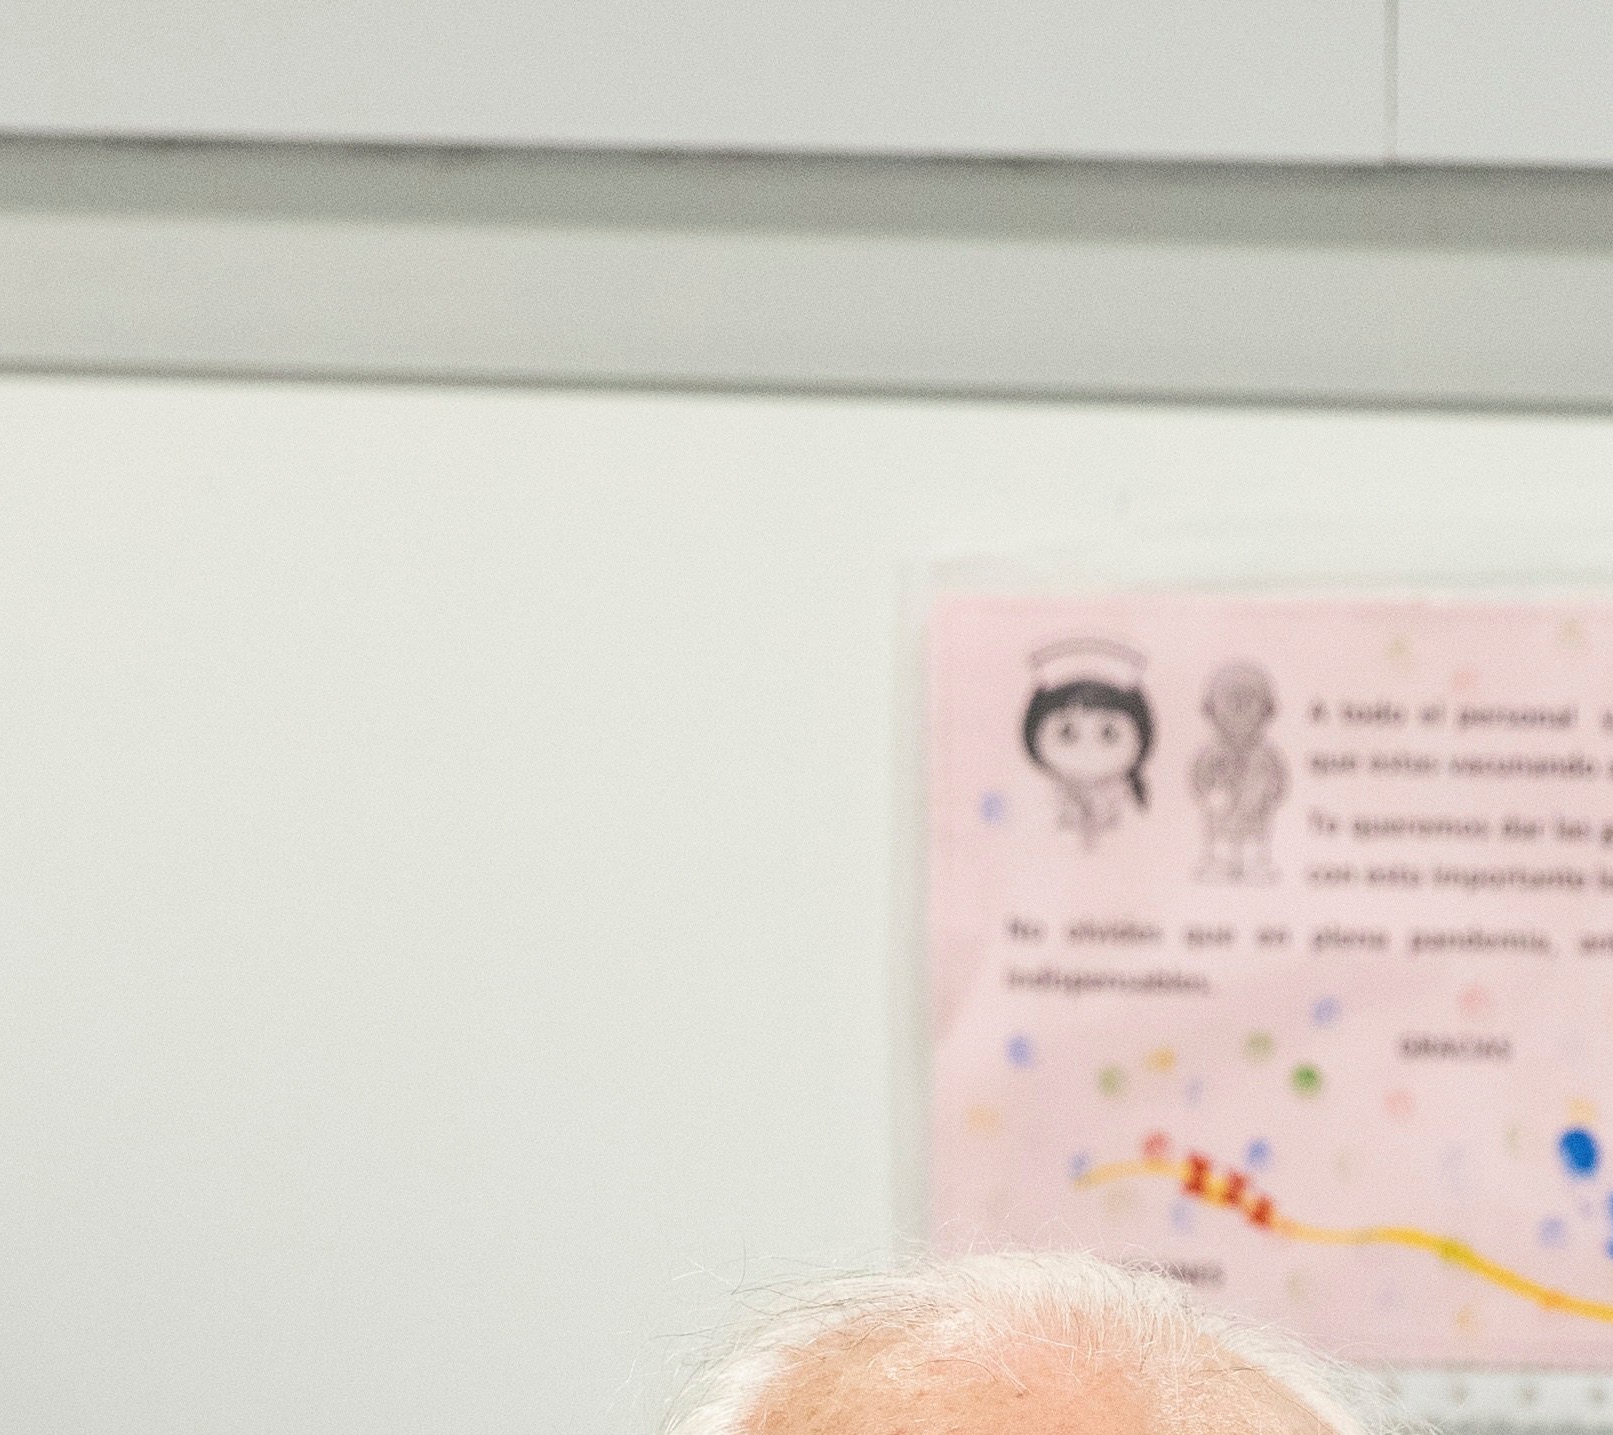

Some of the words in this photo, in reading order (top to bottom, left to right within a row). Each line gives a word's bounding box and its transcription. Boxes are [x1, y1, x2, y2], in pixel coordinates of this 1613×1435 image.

[1456, 704, 1577, 731] personal
[1448, 753, 1600, 778] vacunando
[1349, 816, 1490, 841] queremos
[1431, 868, 1589, 895] importante
[1311, 927, 1389, 953] plena
